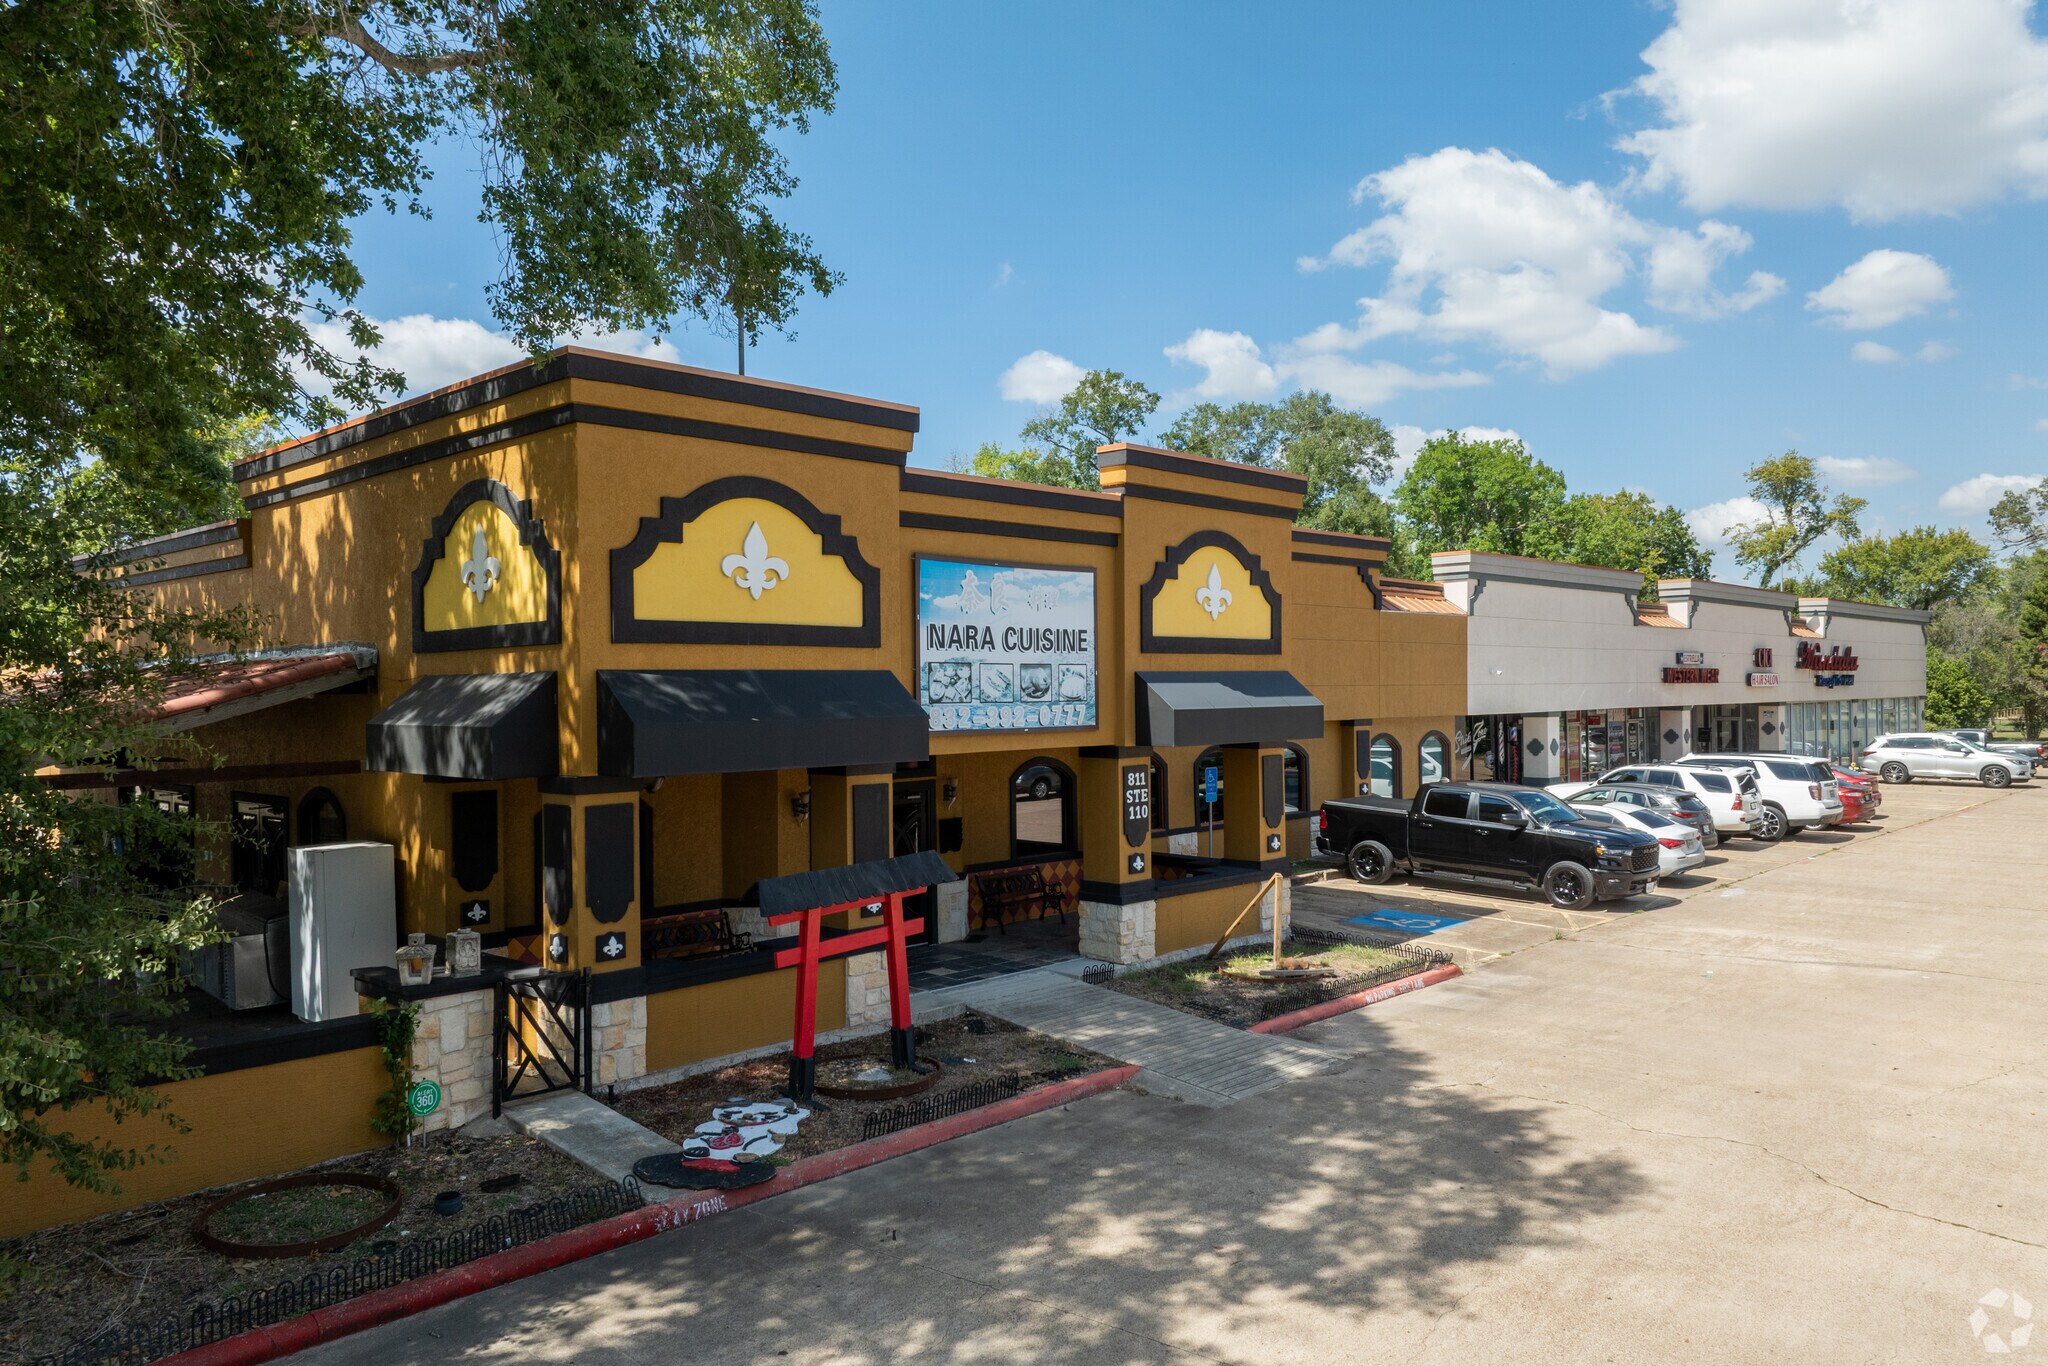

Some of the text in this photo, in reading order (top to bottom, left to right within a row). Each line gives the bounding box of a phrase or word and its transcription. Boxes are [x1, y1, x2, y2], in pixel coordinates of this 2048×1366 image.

[928, 624, 1088, 653] NARA CUISINE
[1667, 668, 1719, 683] WESTERN WEAR
[1752, 674, 1779, 685] HAIR SALON
[929, 704, 1086, 729] 832-392-0777
[1127, 772, 1146, 786] 811
[1126, 788, 1148, 804] STE
[1129, 805, 1148, 819] 110
[416, 1089, 434, 1097] ALERT
[416, 1095, 434, 1108] 360
[693, 1195, 728, 1221] ZONE
